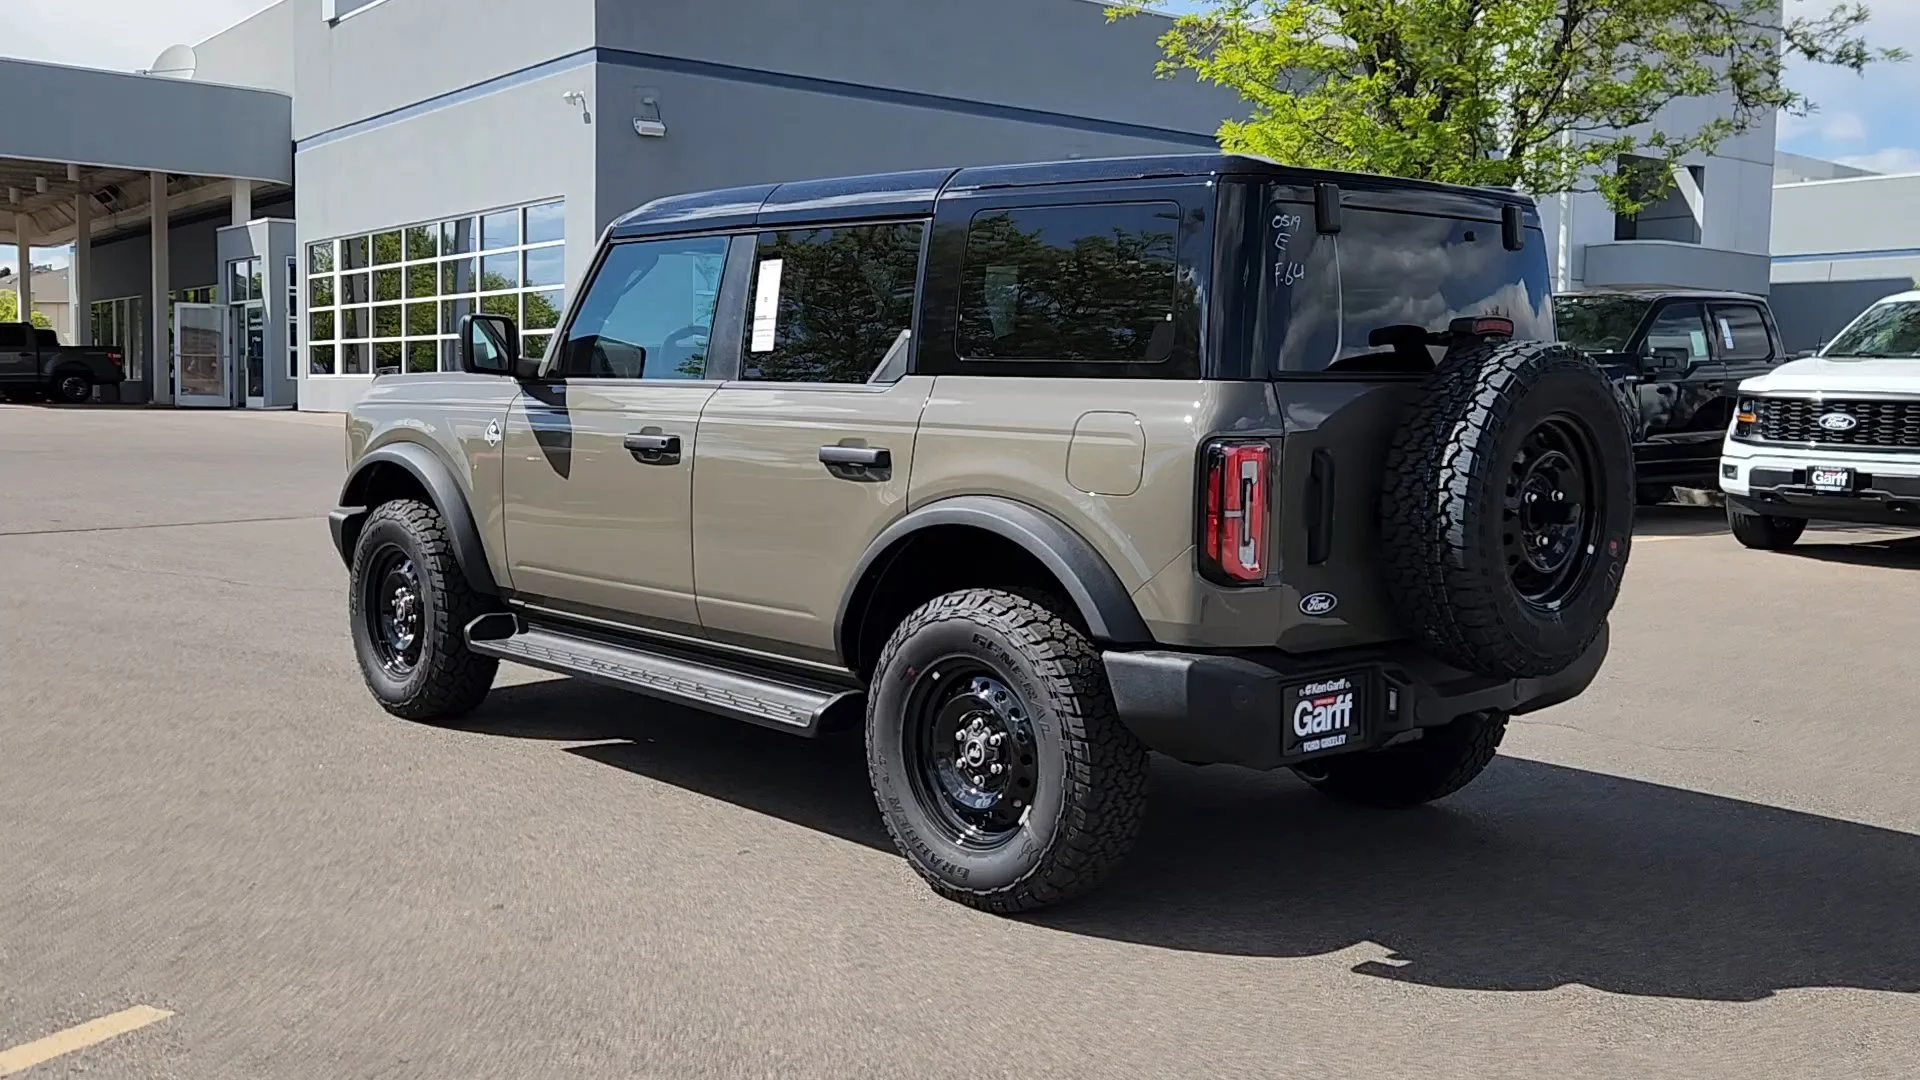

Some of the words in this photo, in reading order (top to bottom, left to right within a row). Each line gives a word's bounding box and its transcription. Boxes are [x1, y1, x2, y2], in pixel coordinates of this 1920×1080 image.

[1275, 232, 1292, 251] E
[1823, 415, 1851, 429] Ford
[1811, 470, 1849, 486] Garff
[1305, 595, 1332, 612] Ford
[1293, 692, 1353, 737] Garff
